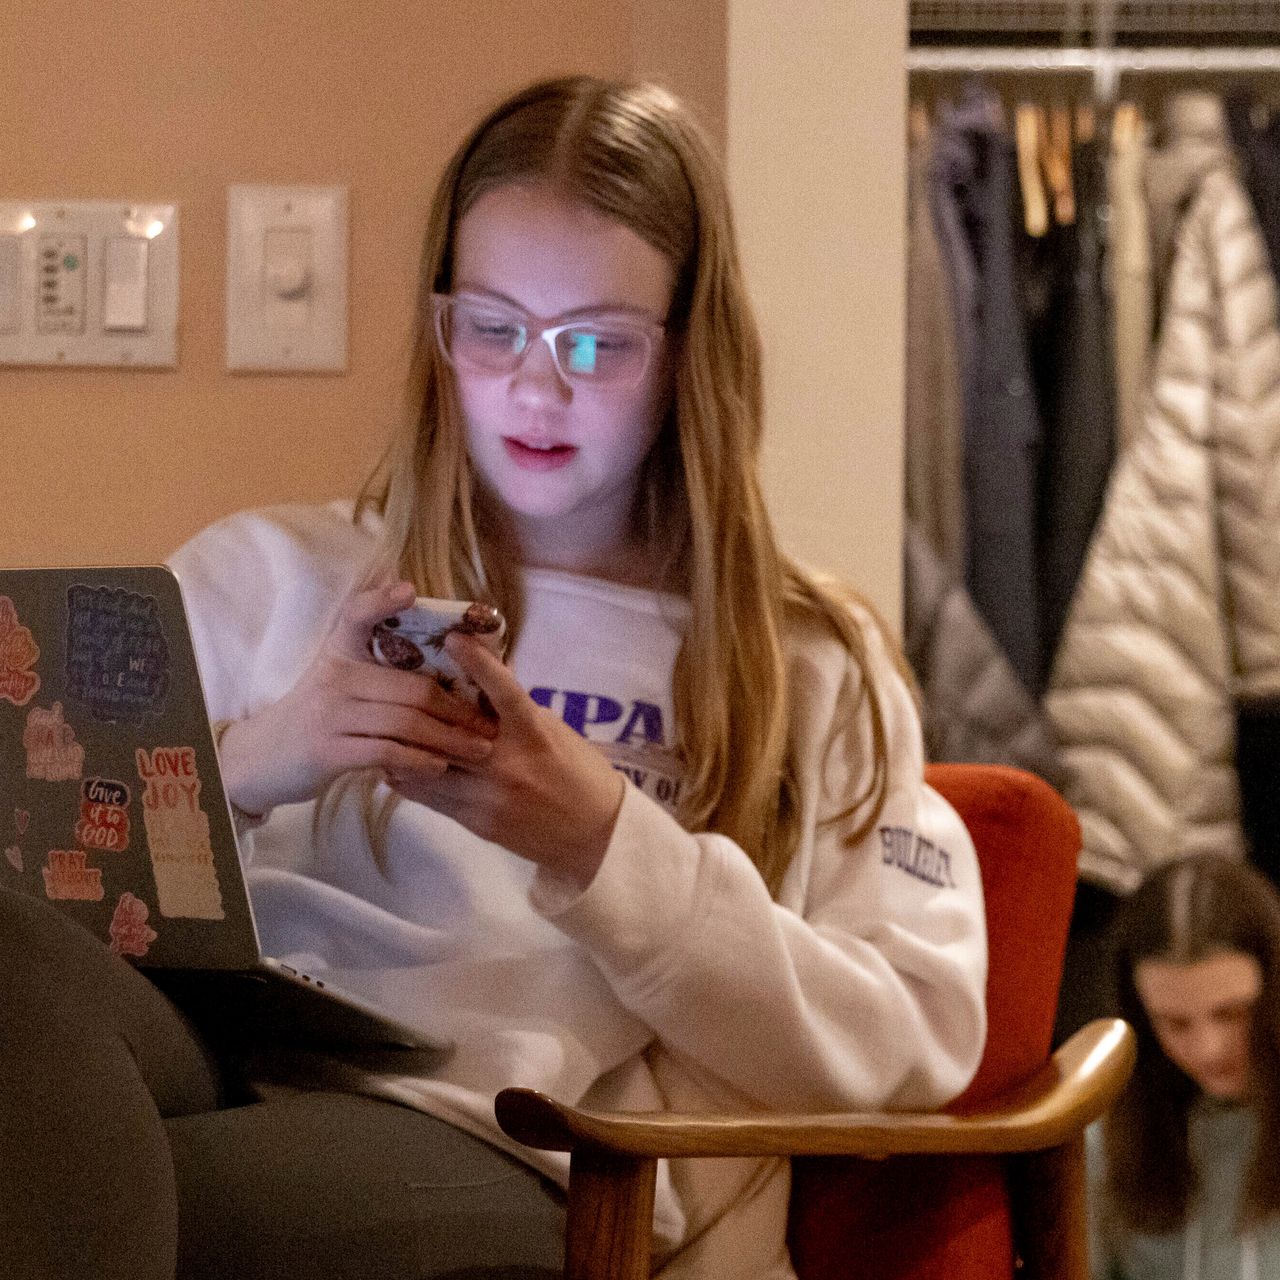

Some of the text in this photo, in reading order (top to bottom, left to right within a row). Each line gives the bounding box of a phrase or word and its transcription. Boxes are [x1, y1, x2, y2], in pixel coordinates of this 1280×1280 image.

[138, 751, 193, 777] LOVE
[88, 776, 121, 805] Give
[145, 782, 196, 813] JOY
[106, 804, 121, 825] to
[81, 822, 119, 848] GOD
